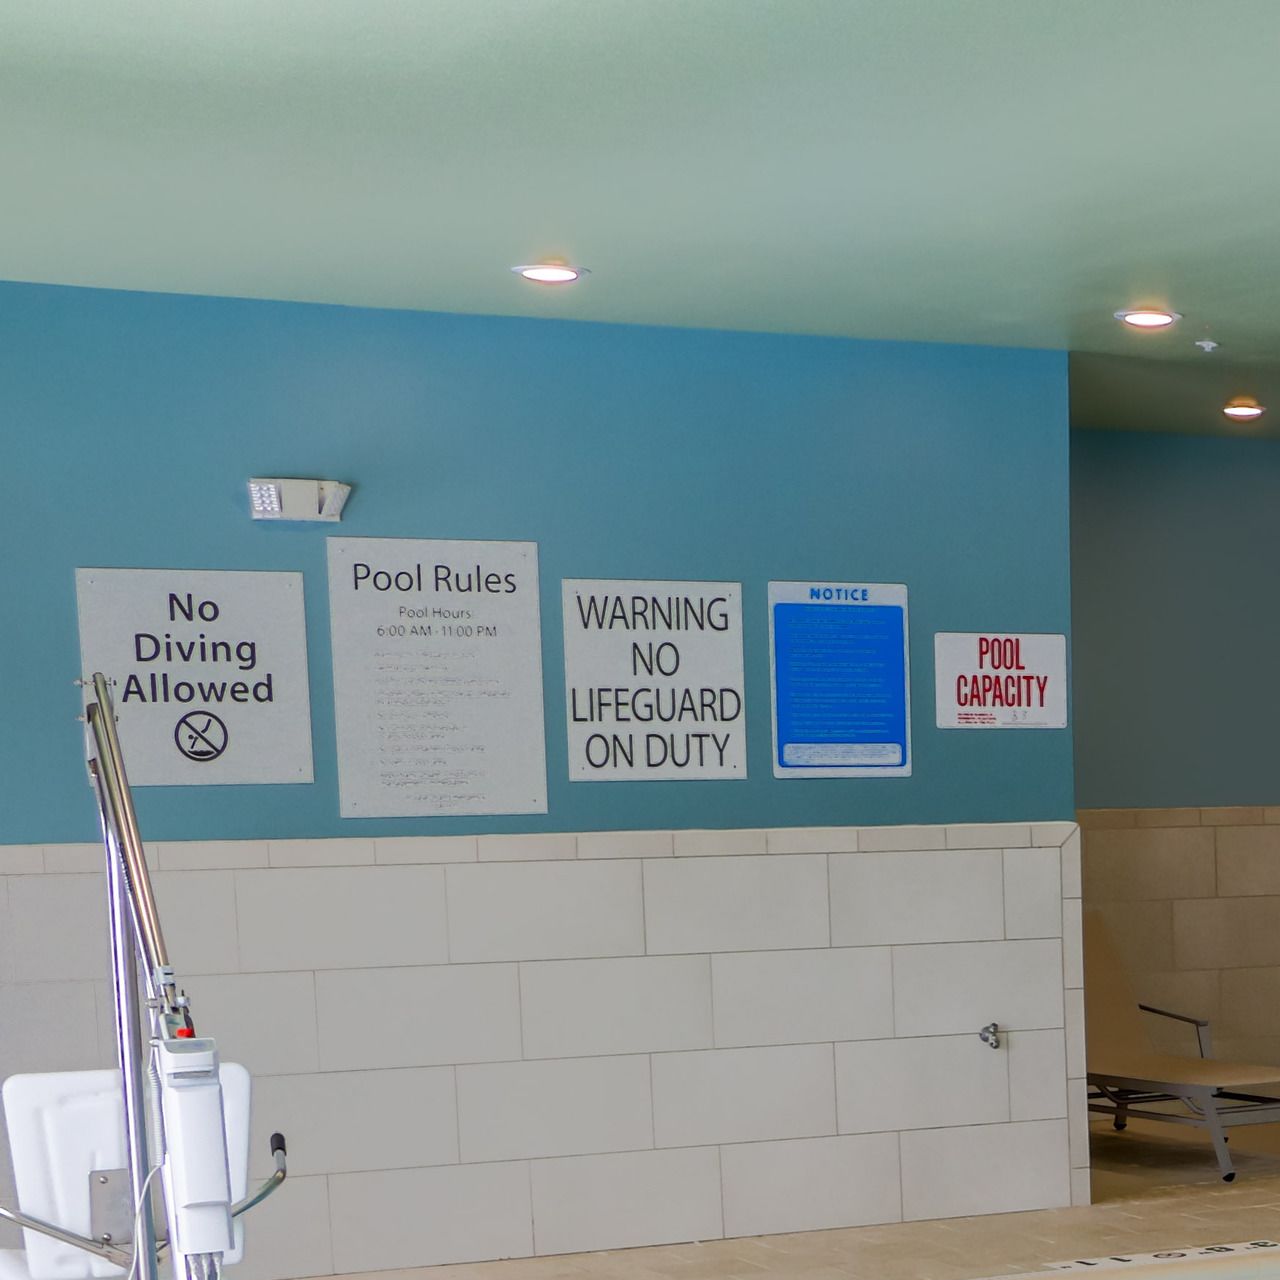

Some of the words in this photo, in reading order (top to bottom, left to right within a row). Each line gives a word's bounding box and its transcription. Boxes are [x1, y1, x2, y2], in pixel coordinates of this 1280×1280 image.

[353, 563, 422, 592] Pool
[434, 565, 517, 593] Rules
[168, 594, 219, 622] No
[809, 588, 869, 602] NOTICE
[399, 606, 427, 618] Pool
[432, 607, 472, 619] Hours
[576, 596, 729, 631] WARNING
[377, 625, 406, 637] 6:00
[409, 626, 432, 637] AM
[477, 626, 498, 637] PM
[134, 633, 257, 669] Diving
[631, 641, 681, 677] NO
[978, 637, 1026, 671] POOL
[121, 673, 275, 703] Allowed
[956, 675, 1049, 708] CAPACITY
[571, 687, 741, 723] LIFEGUARD
[585, 733, 634, 769] ON
[645, 733, 731, 770] DUTY
